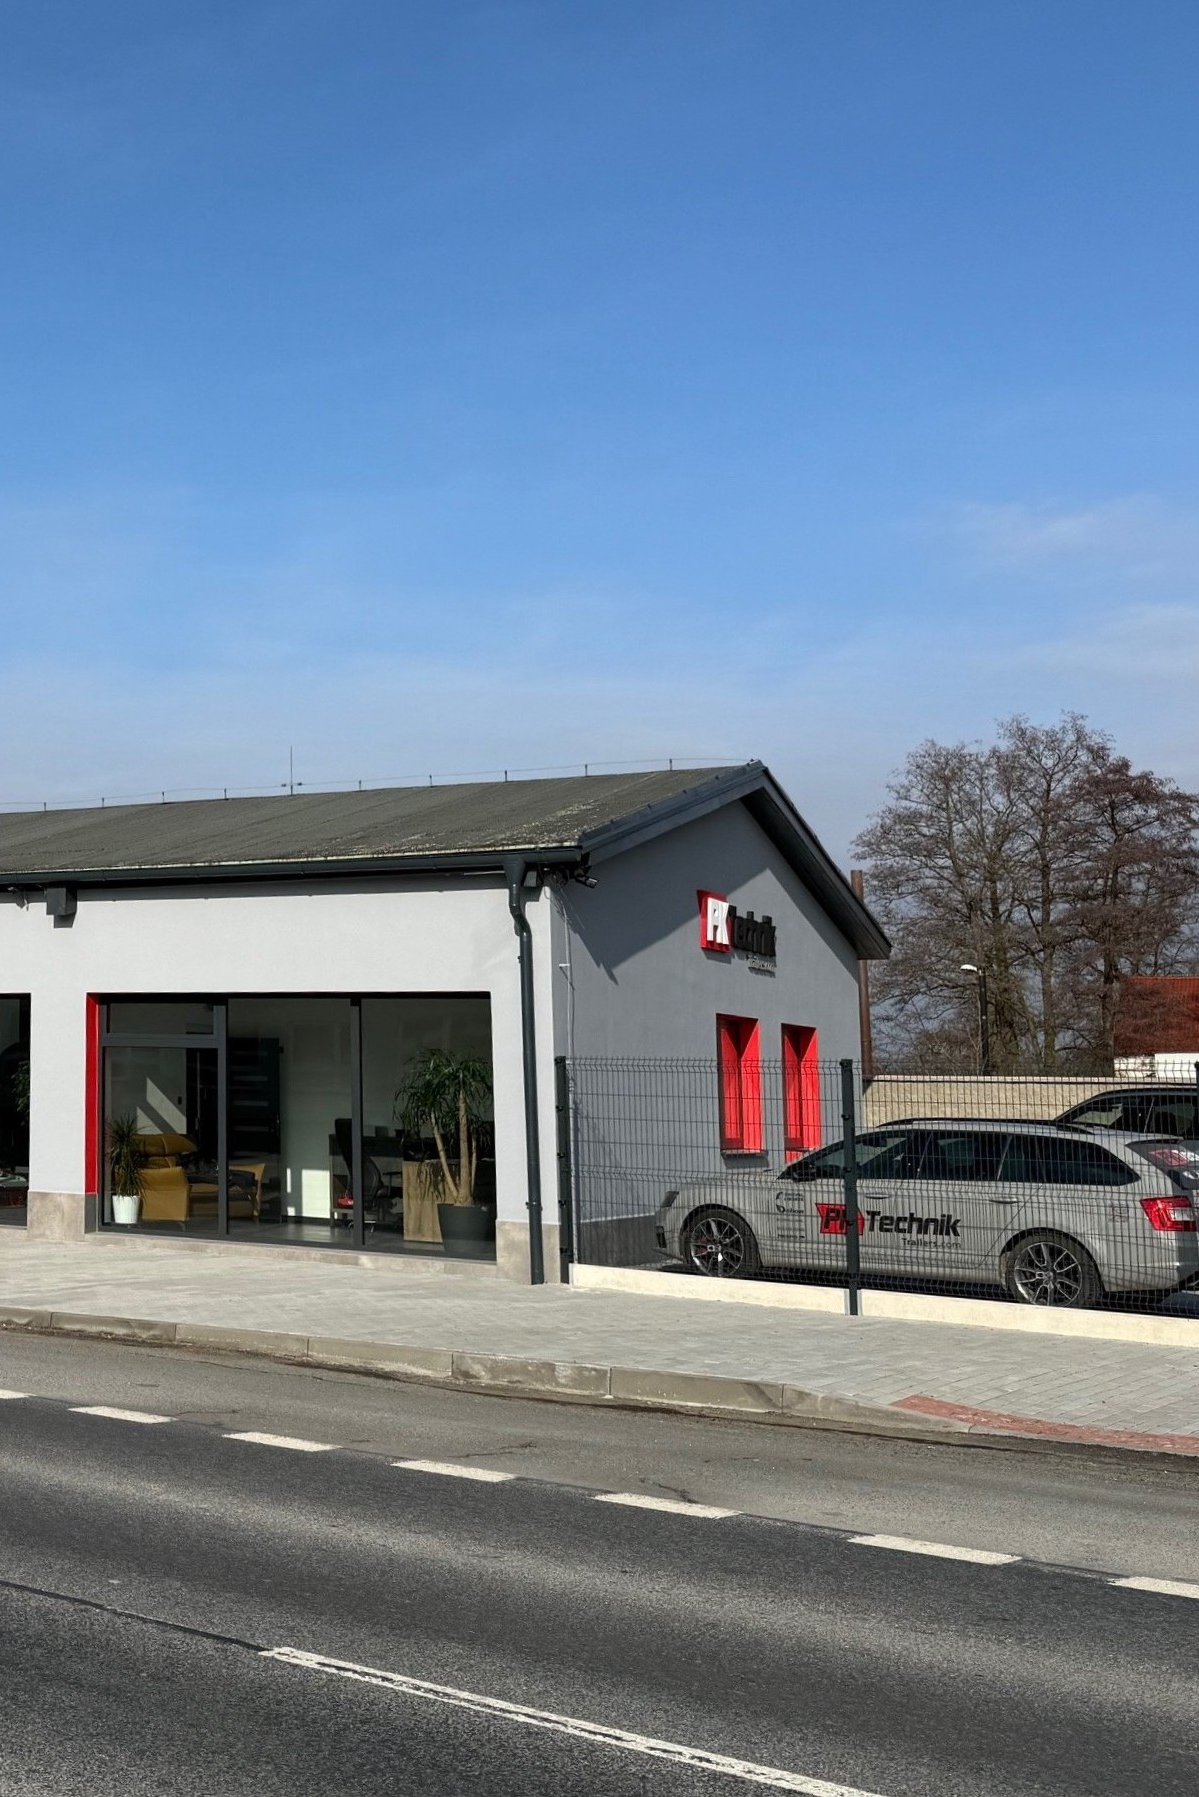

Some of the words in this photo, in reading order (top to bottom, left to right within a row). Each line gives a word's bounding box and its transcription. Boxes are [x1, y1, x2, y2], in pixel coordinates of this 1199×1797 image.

[706, 897, 730, 945] PK
[866, 1210, 962, 1237] Technik
[902, 1238, 962, 1249] Trailers.com
